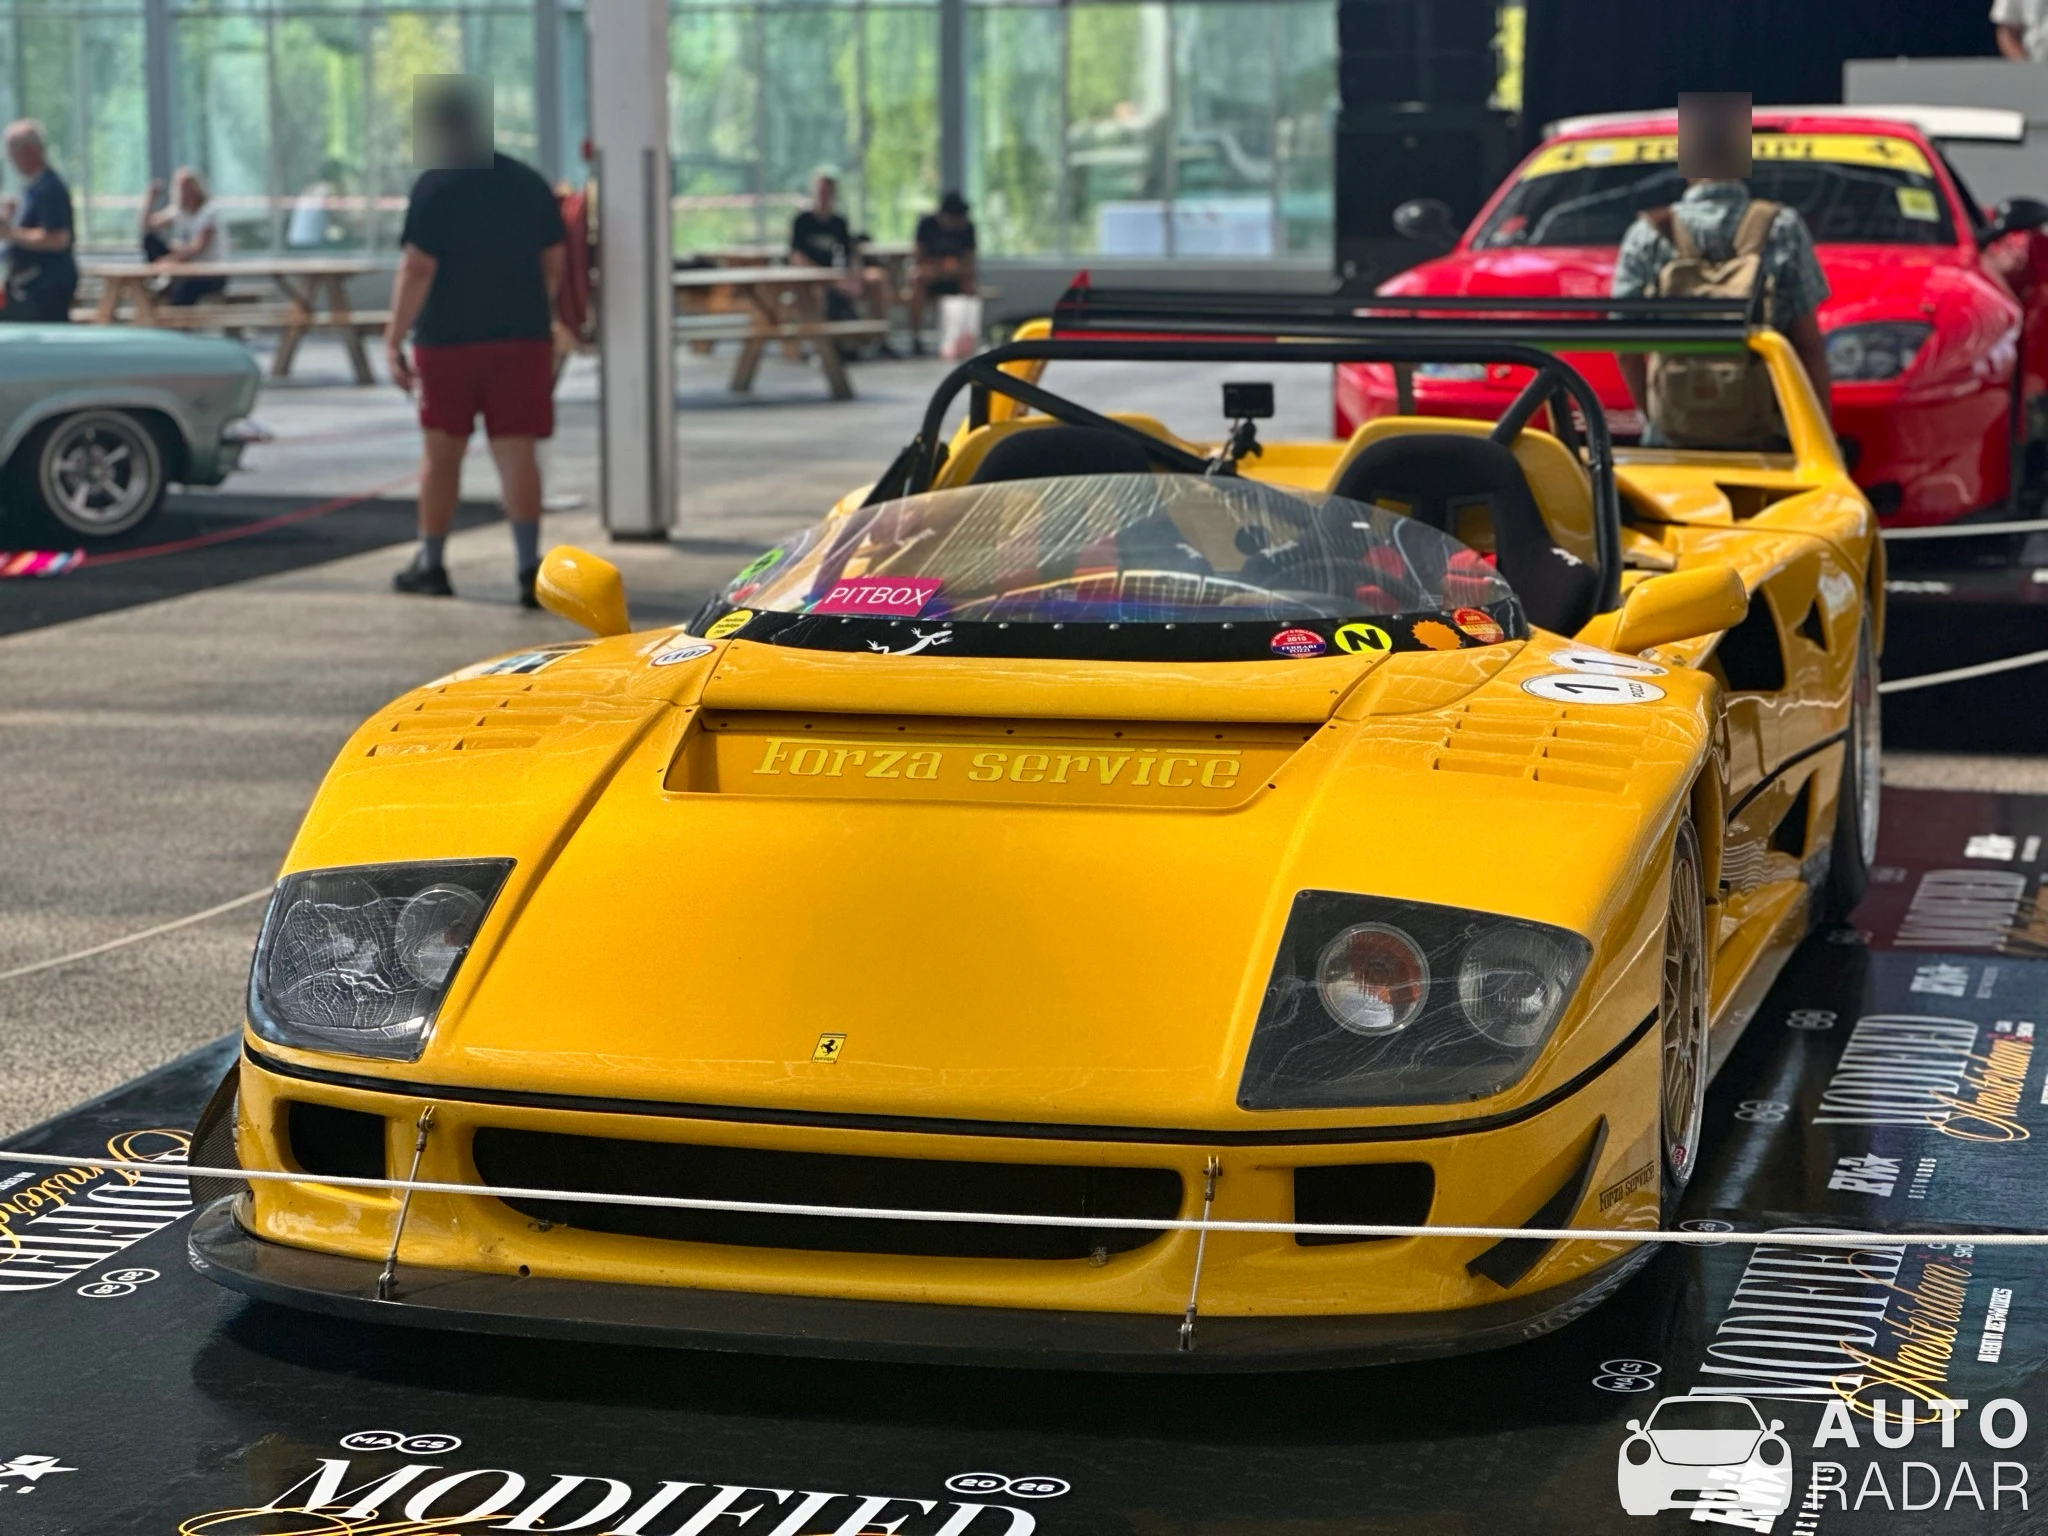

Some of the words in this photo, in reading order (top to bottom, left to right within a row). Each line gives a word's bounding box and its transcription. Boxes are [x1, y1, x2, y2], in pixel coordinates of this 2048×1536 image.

[824, 586, 933, 606] PITBOX
[1342, 628, 1386, 652] N
[752, 737, 944, 780] Forza
[966, 746, 1243, 790] service
[1620, 1362, 1642, 1374] CS
[1612, 1376, 1636, 1390] MA
[351, 1433, 393, 1447] MA
[409, 1437, 446, 1449] CS
[957, 1477, 997, 1489] 20
[1017, 1482, 1055, 1494] 26
[258, 1457, 1037, 1536] MODIFIED
